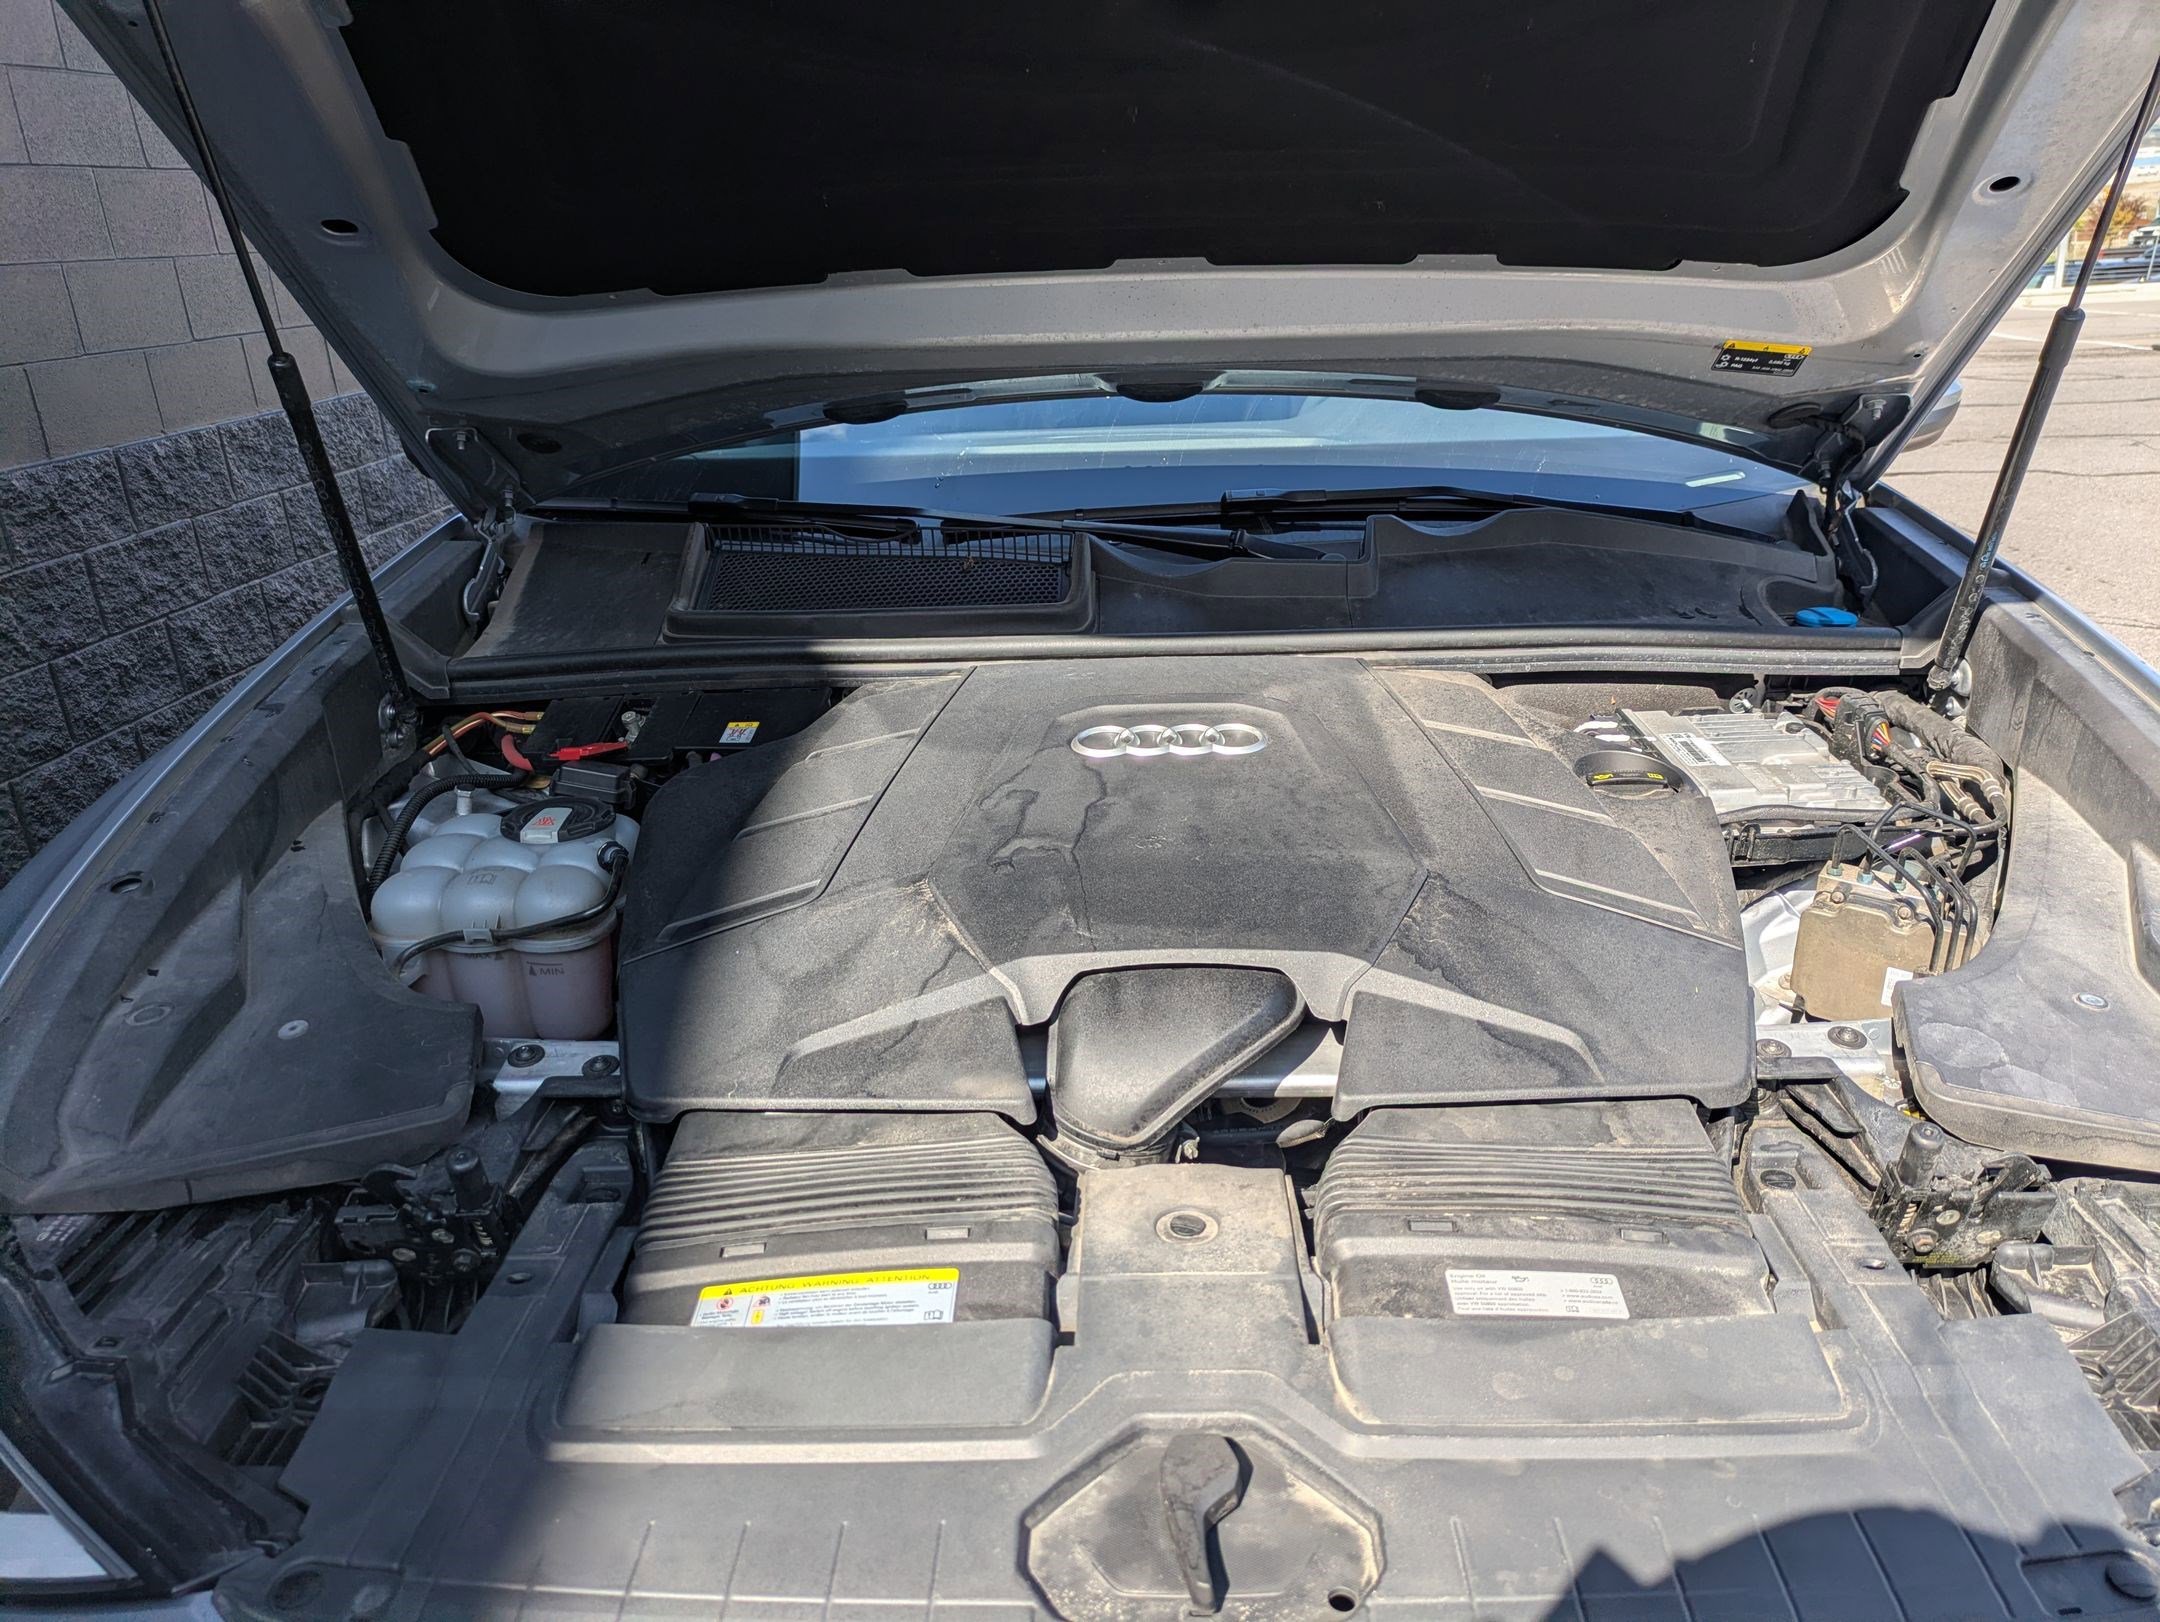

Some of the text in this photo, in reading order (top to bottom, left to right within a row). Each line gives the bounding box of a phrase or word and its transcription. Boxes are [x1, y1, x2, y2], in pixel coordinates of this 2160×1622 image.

[539, 967, 565, 976] MIN
[739, 1284, 795, 1293] ACHTUNG
[802, 1279, 860, 1289] WARNING
[866, 1274, 930, 1283] ATTENTION
